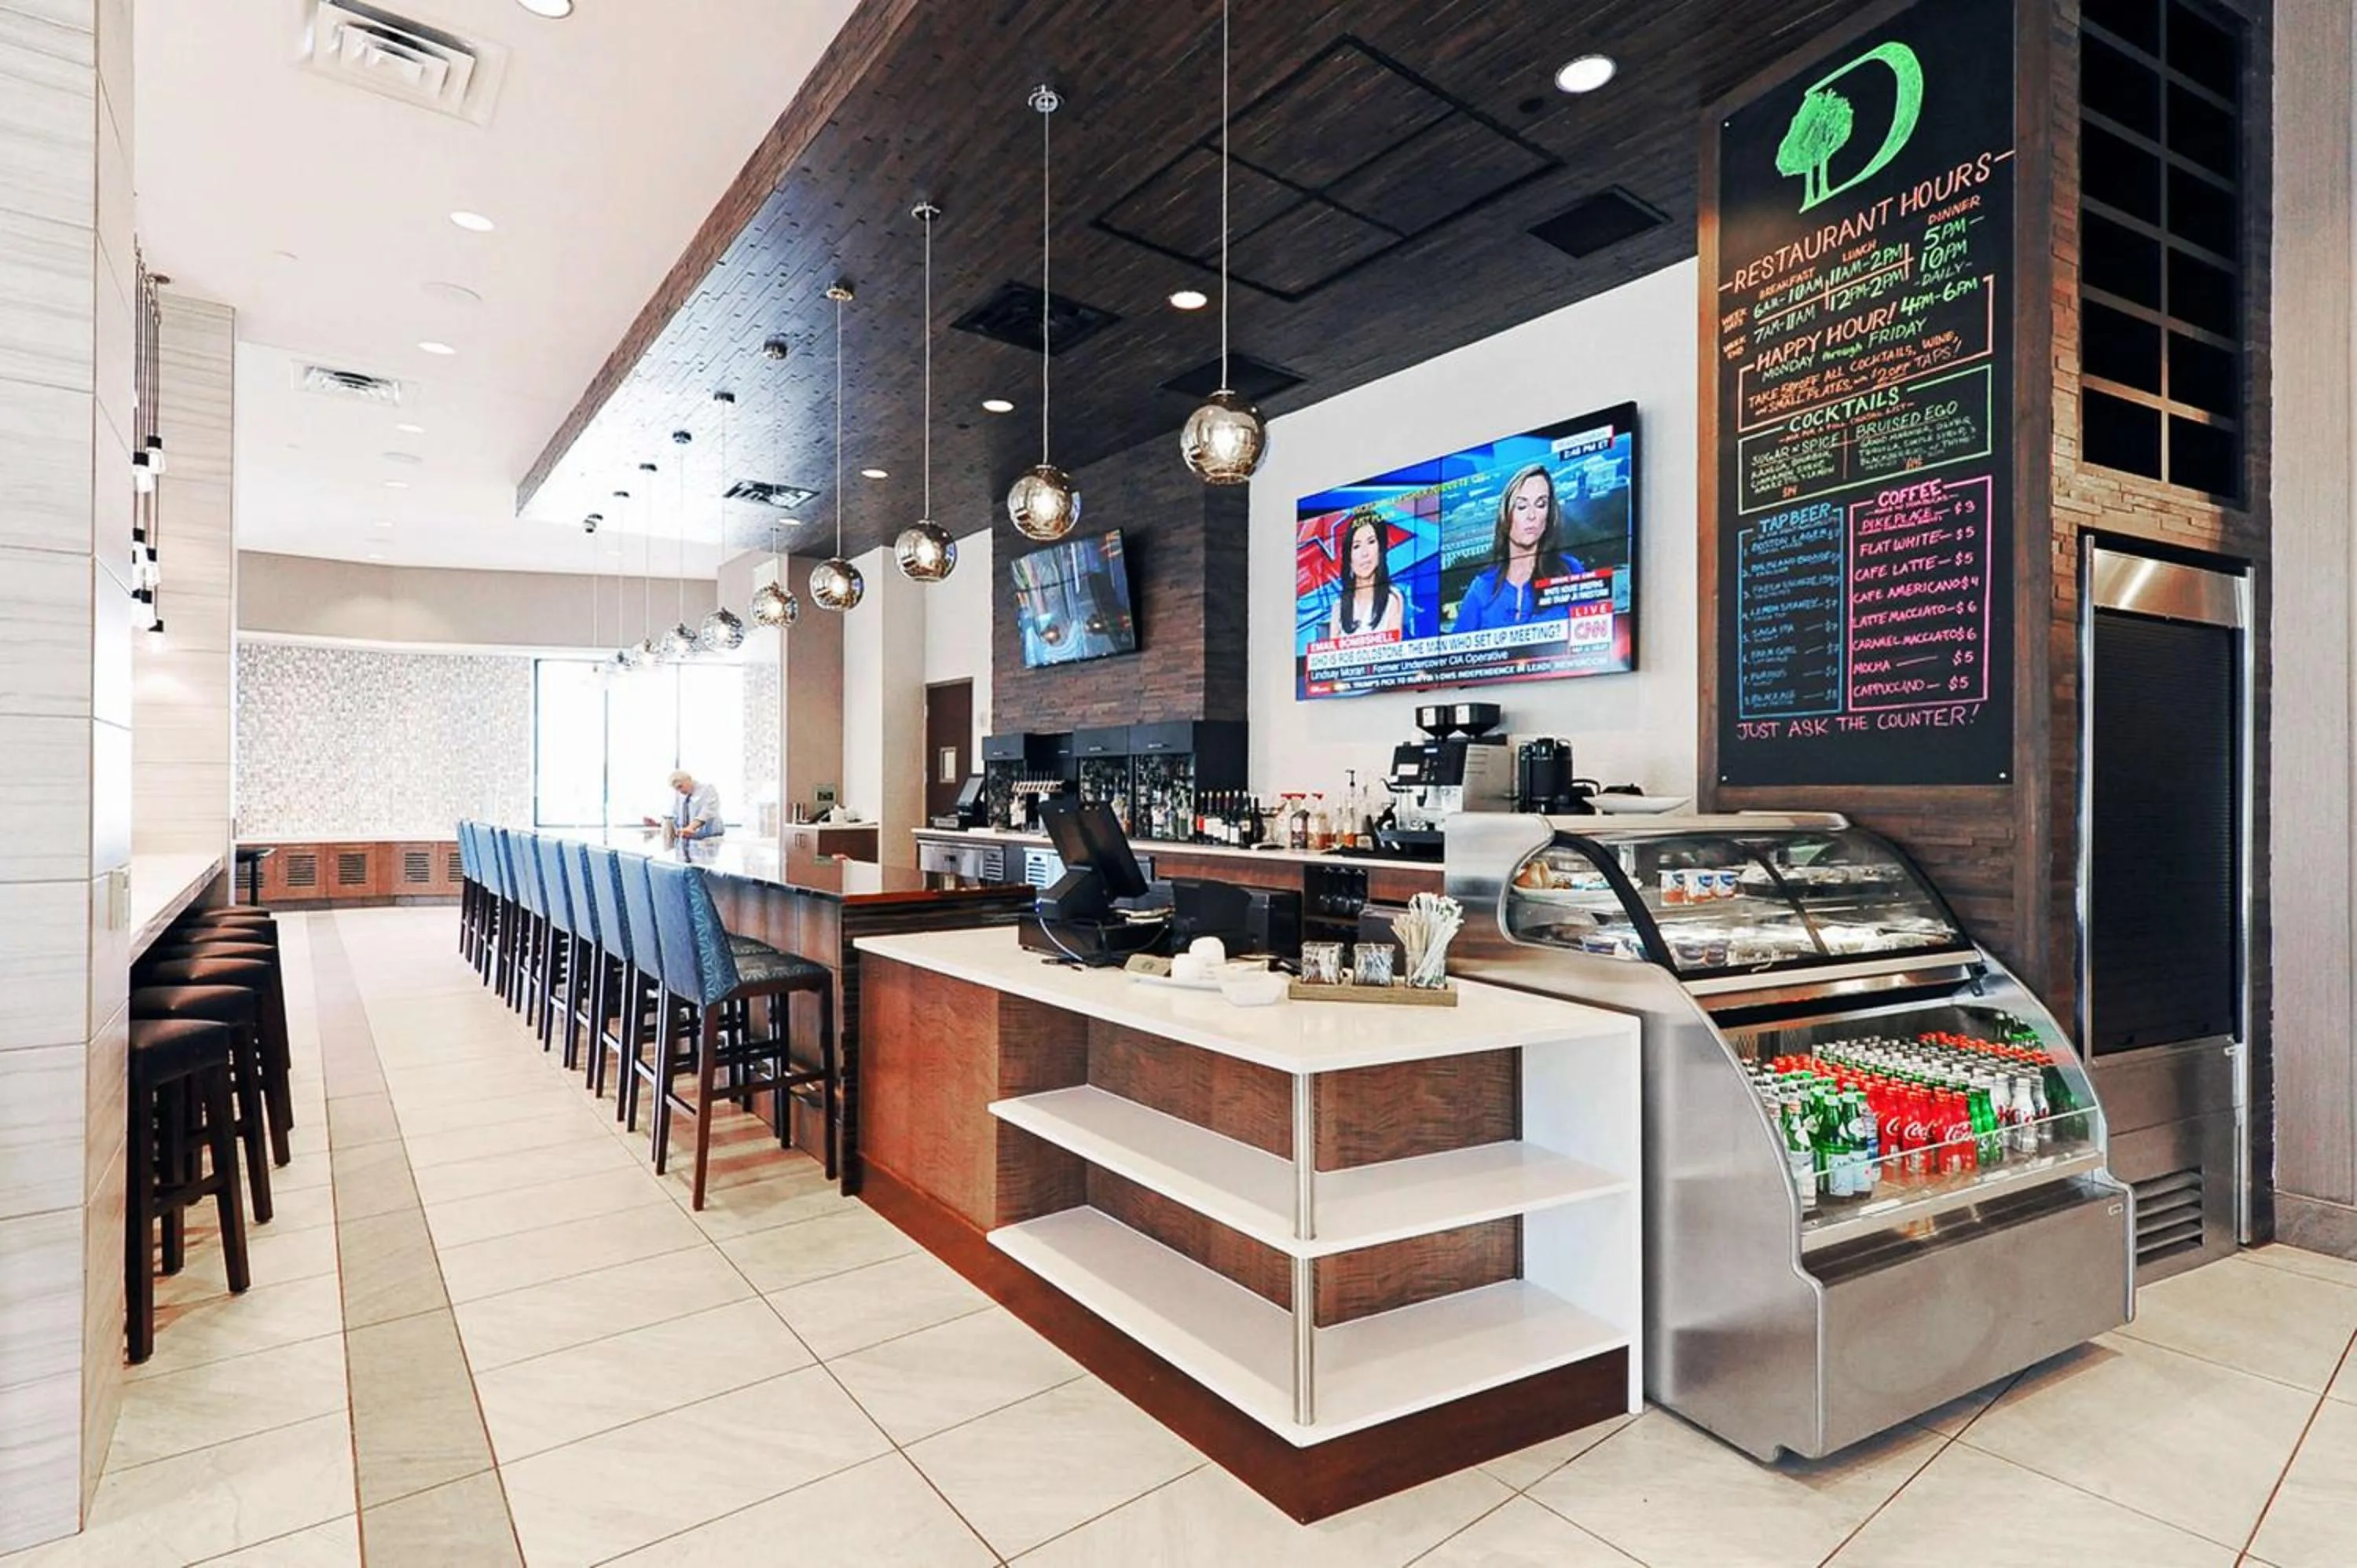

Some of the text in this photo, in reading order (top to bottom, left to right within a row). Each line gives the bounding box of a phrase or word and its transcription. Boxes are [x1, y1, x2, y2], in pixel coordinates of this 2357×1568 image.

[1734, 152, 1992, 293] RESTAURANT HOURS
[1759, 195, 1981, 300] BREAKFAST LUNCH DINNER
[1919, 239, 1967, 273] 10PM
[1756, 331, 1822, 372] HAPPY
[1826, 301, 1897, 346] HOUR!
[1761, 354, 1815, 383] MONDAY
[1868, 317, 1928, 350] FRIDAY
[1914, 339, 1963, 368] TAPS!
[1748, 387, 1780, 409] TAKE
[1824, 365, 1846, 383] ALL
[1789, 386, 1900, 432] COCKTAILS
[1856, 400, 1959, 439] BRUISED EGO
[1750, 446, 1790, 466] SUGAR
[1802, 432, 1841, 453] SPICE
[1878, 478, 1942, 507] COFFEE
[1789, 503, 1831, 526] BEER
[1861, 513, 1893, 532] PIKE
[1894, 508, 1933, 526] PLACE
[1860, 537, 1892, 558] FLAT
[1893, 529, 1945, 551] WHITE
[1854, 565, 1887, 582] CAFE
[1892, 555, 1939, 576] LATTE
[1853, 590, 1884, 604] CAFE
[1887, 579, 1960, 599] AMERICANO
[1575, 603, 1607, 617] LIVE
[1852, 612, 1888, 628] LATTE
[1408, 641, 1424, 654] THE
[1427, 638, 1448, 653] MAN
[1448, 634, 1472, 650] WHO
[1474, 632, 1492, 647] SET
[1494, 630, 1506, 645] UP
[1509, 623, 1562, 643] MEETING?
[1574, 619, 1608, 640] CNN
[1852, 634, 1901, 651] CARAMEL
[1373, 662, 1399, 673] Former
[1401, 656, 1447, 669] Undercover
[1448, 654, 1464, 666] CIA
[1466, 650, 1509, 665] Operative
[1458, 665, 1515, 679] INDEPENDENCE
[1853, 649, 1974, 675] MOCHA $5
[1948, 675, 1970, 691] $5
[1736, 704, 1979, 741] JUST ASK THE COUNTER!
